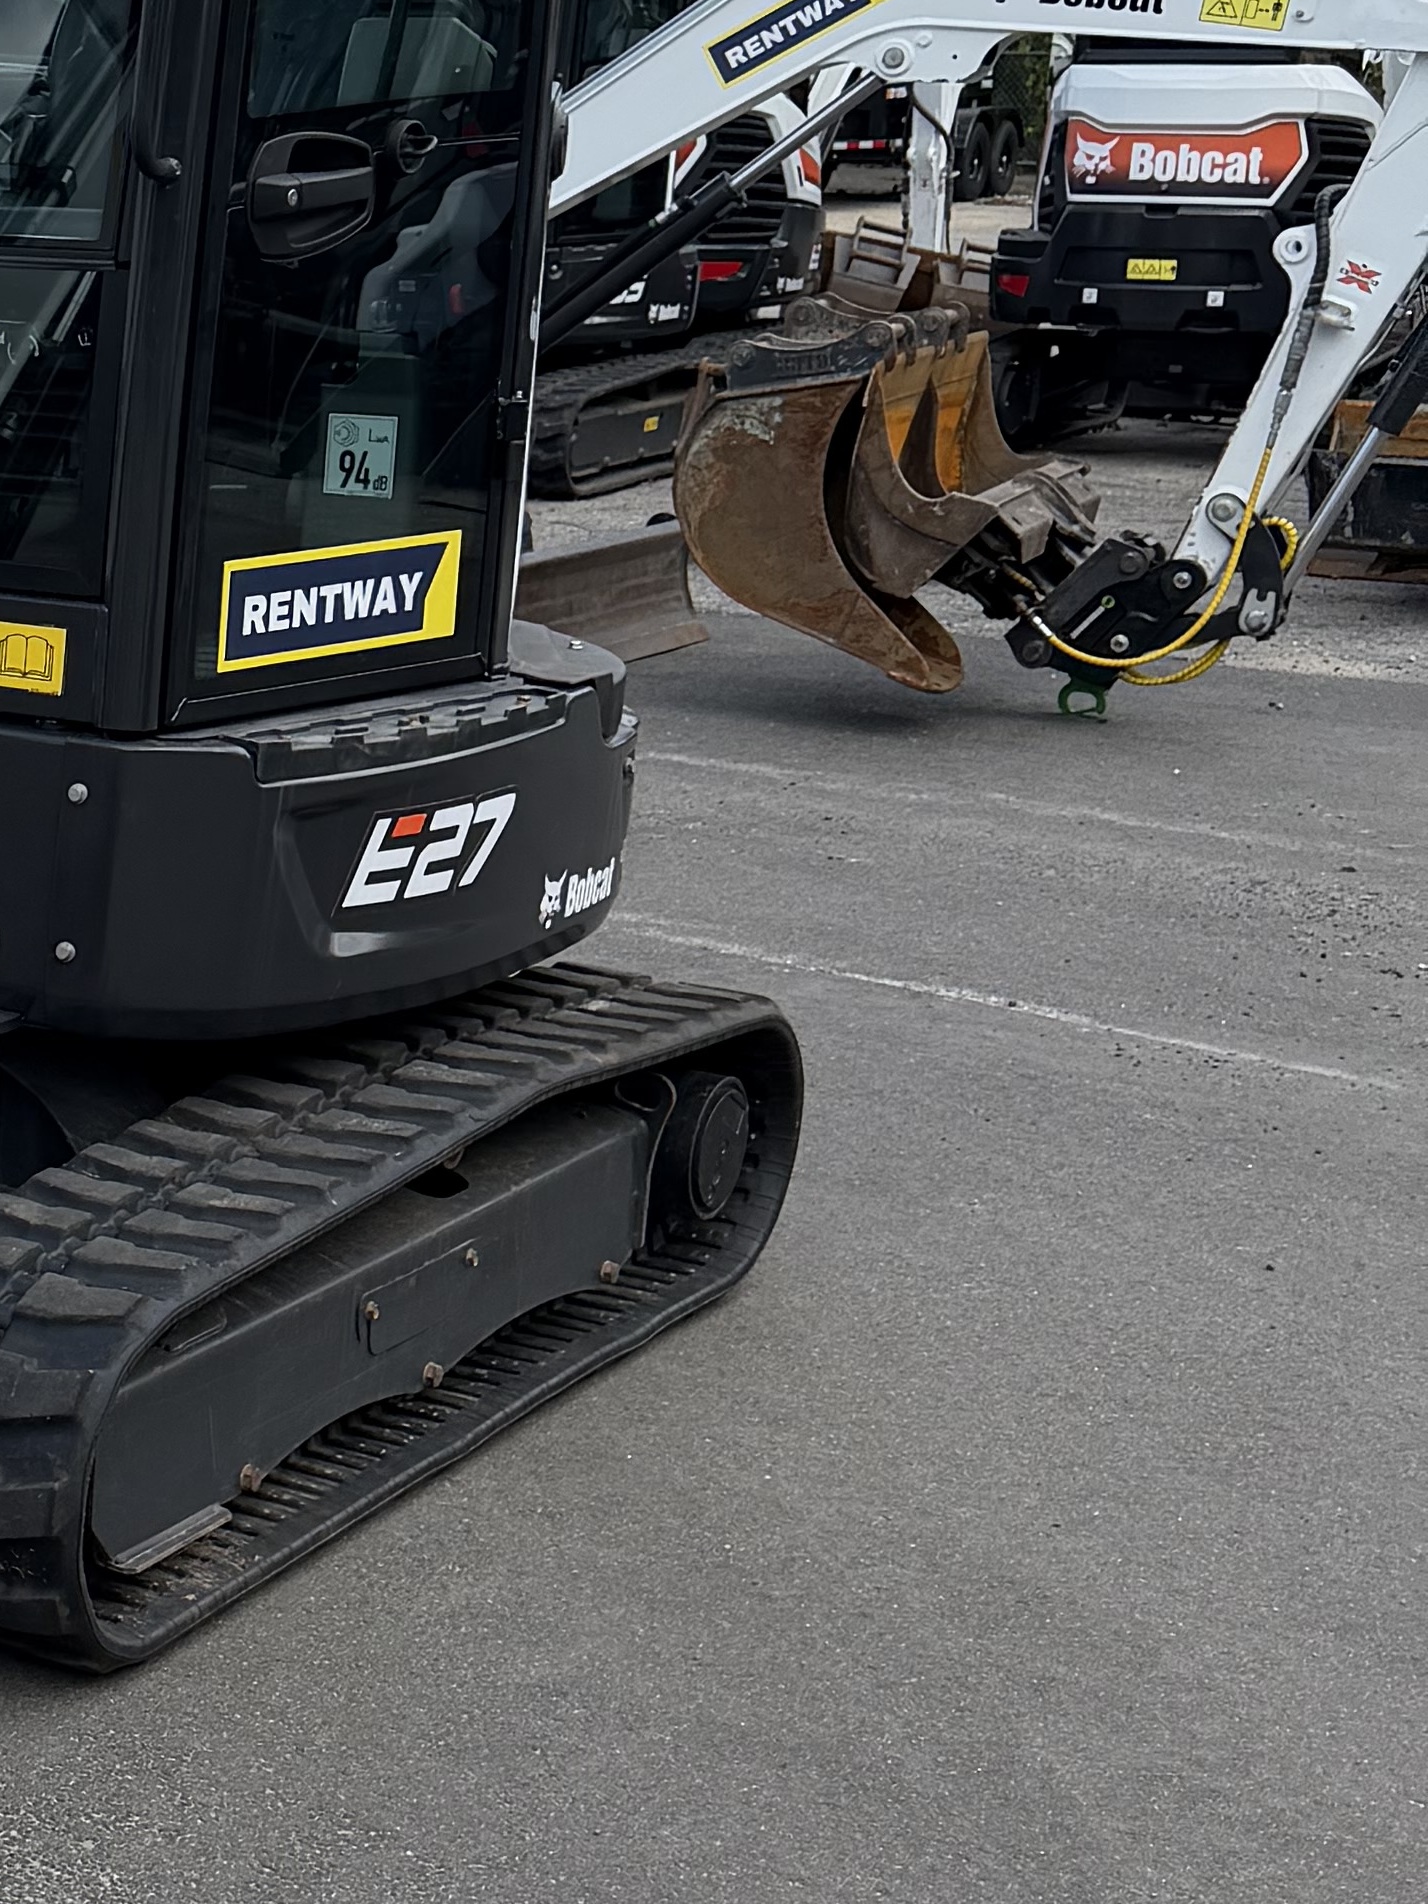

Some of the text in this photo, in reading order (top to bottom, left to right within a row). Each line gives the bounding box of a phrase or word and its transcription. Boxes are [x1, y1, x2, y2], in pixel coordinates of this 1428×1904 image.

[1128, 142, 1263, 185] Bobcat
[339, 449, 389, 491] 94 dB
[242, 571, 423, 636] RENTWAY
[342, 793, 517, 909] E27
[564, 857, 616, 918] Bobcat
